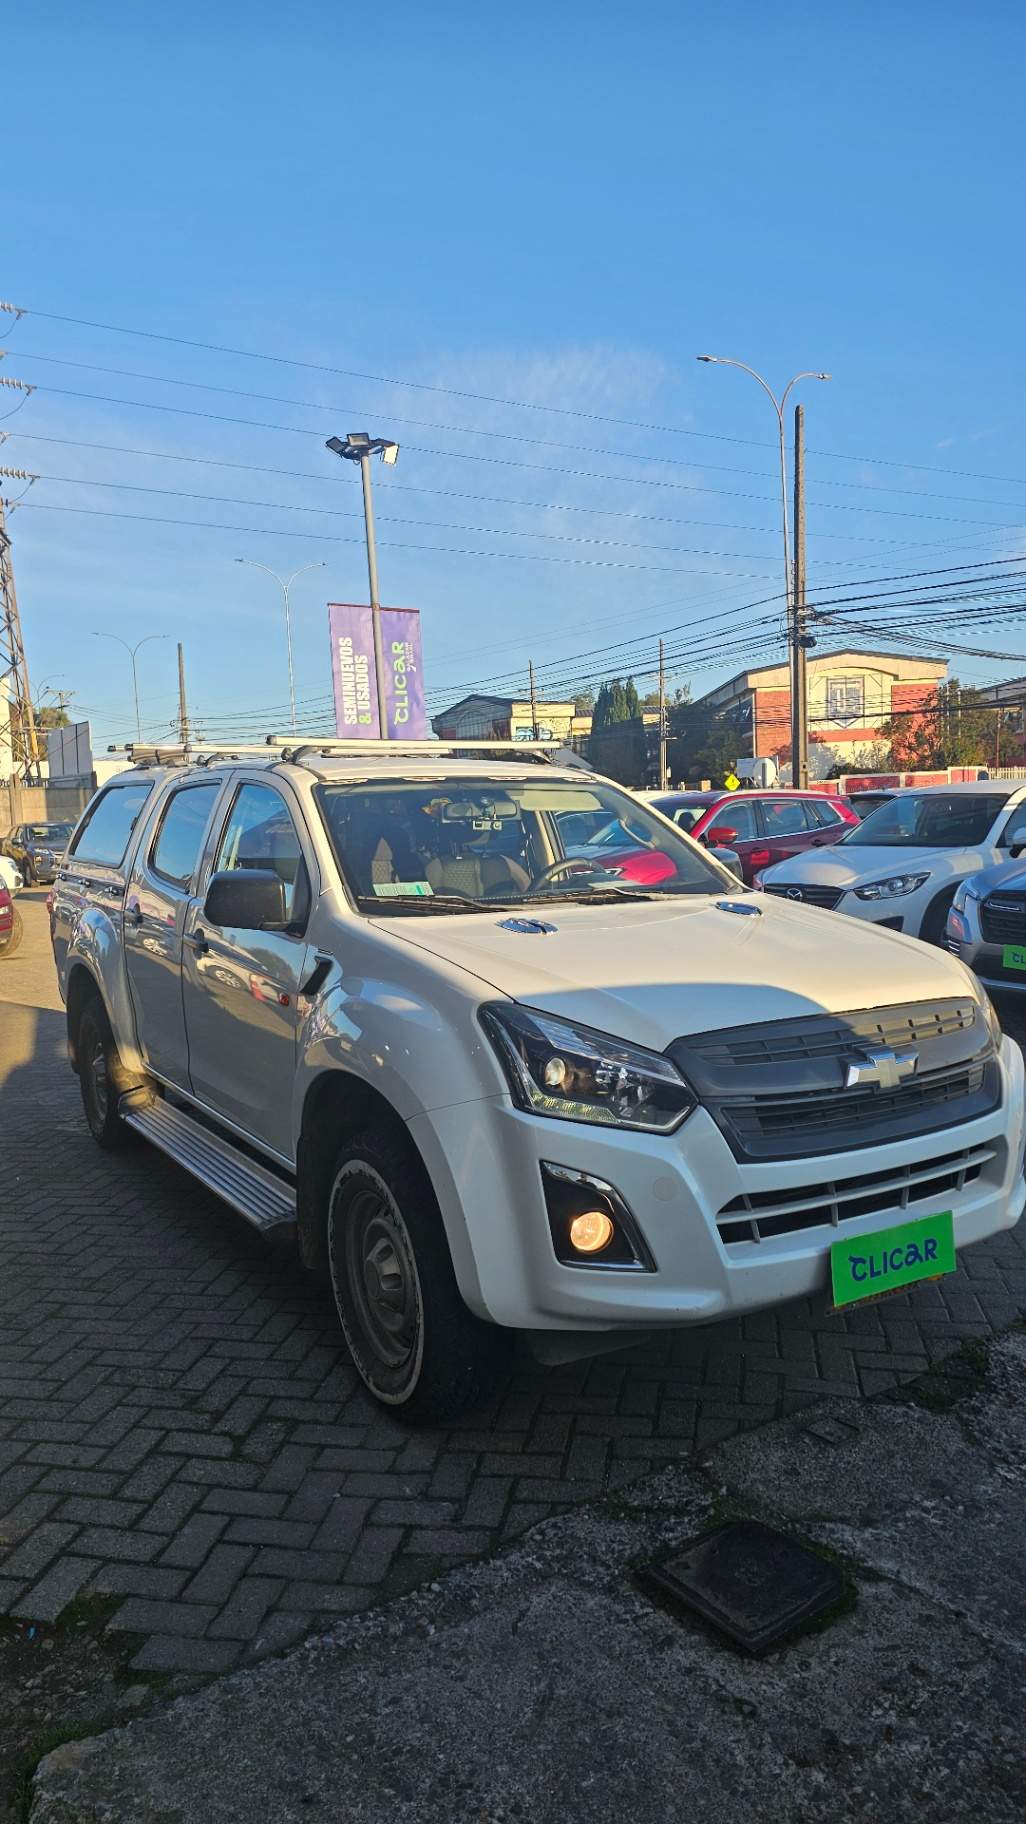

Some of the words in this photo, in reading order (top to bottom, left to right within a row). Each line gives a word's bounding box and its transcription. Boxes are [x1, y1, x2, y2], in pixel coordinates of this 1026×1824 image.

[339, 637, 357, 725] SEMINUEVOS
[355, 655, 370, 710] USADOS
[359, 712, 372, 725] &
